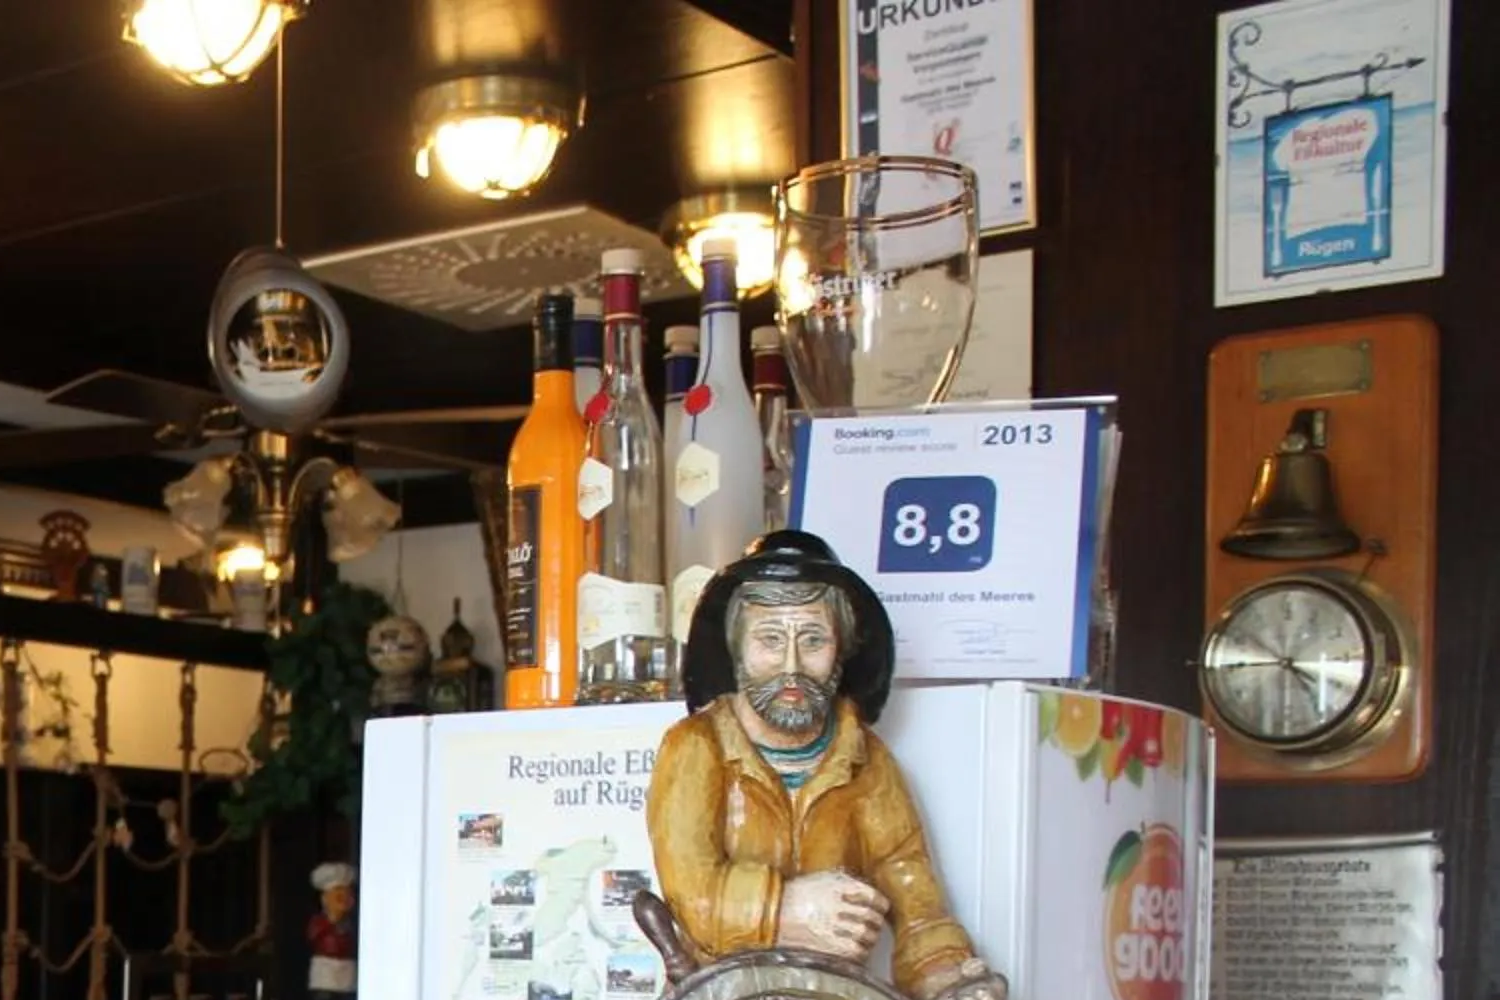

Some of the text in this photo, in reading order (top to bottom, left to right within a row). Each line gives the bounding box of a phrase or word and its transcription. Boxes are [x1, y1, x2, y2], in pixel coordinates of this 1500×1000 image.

[858, 0, 997, 34] URKUN
[1299, 237, 1355, 257] Rügen
[834, 423, 1053, 446] Booking.com 2013
[893, 502, 981, 554] 8,8
[508, 751, 617, 784] Regionale
[553, 780, 645, 812] auf Rüg
